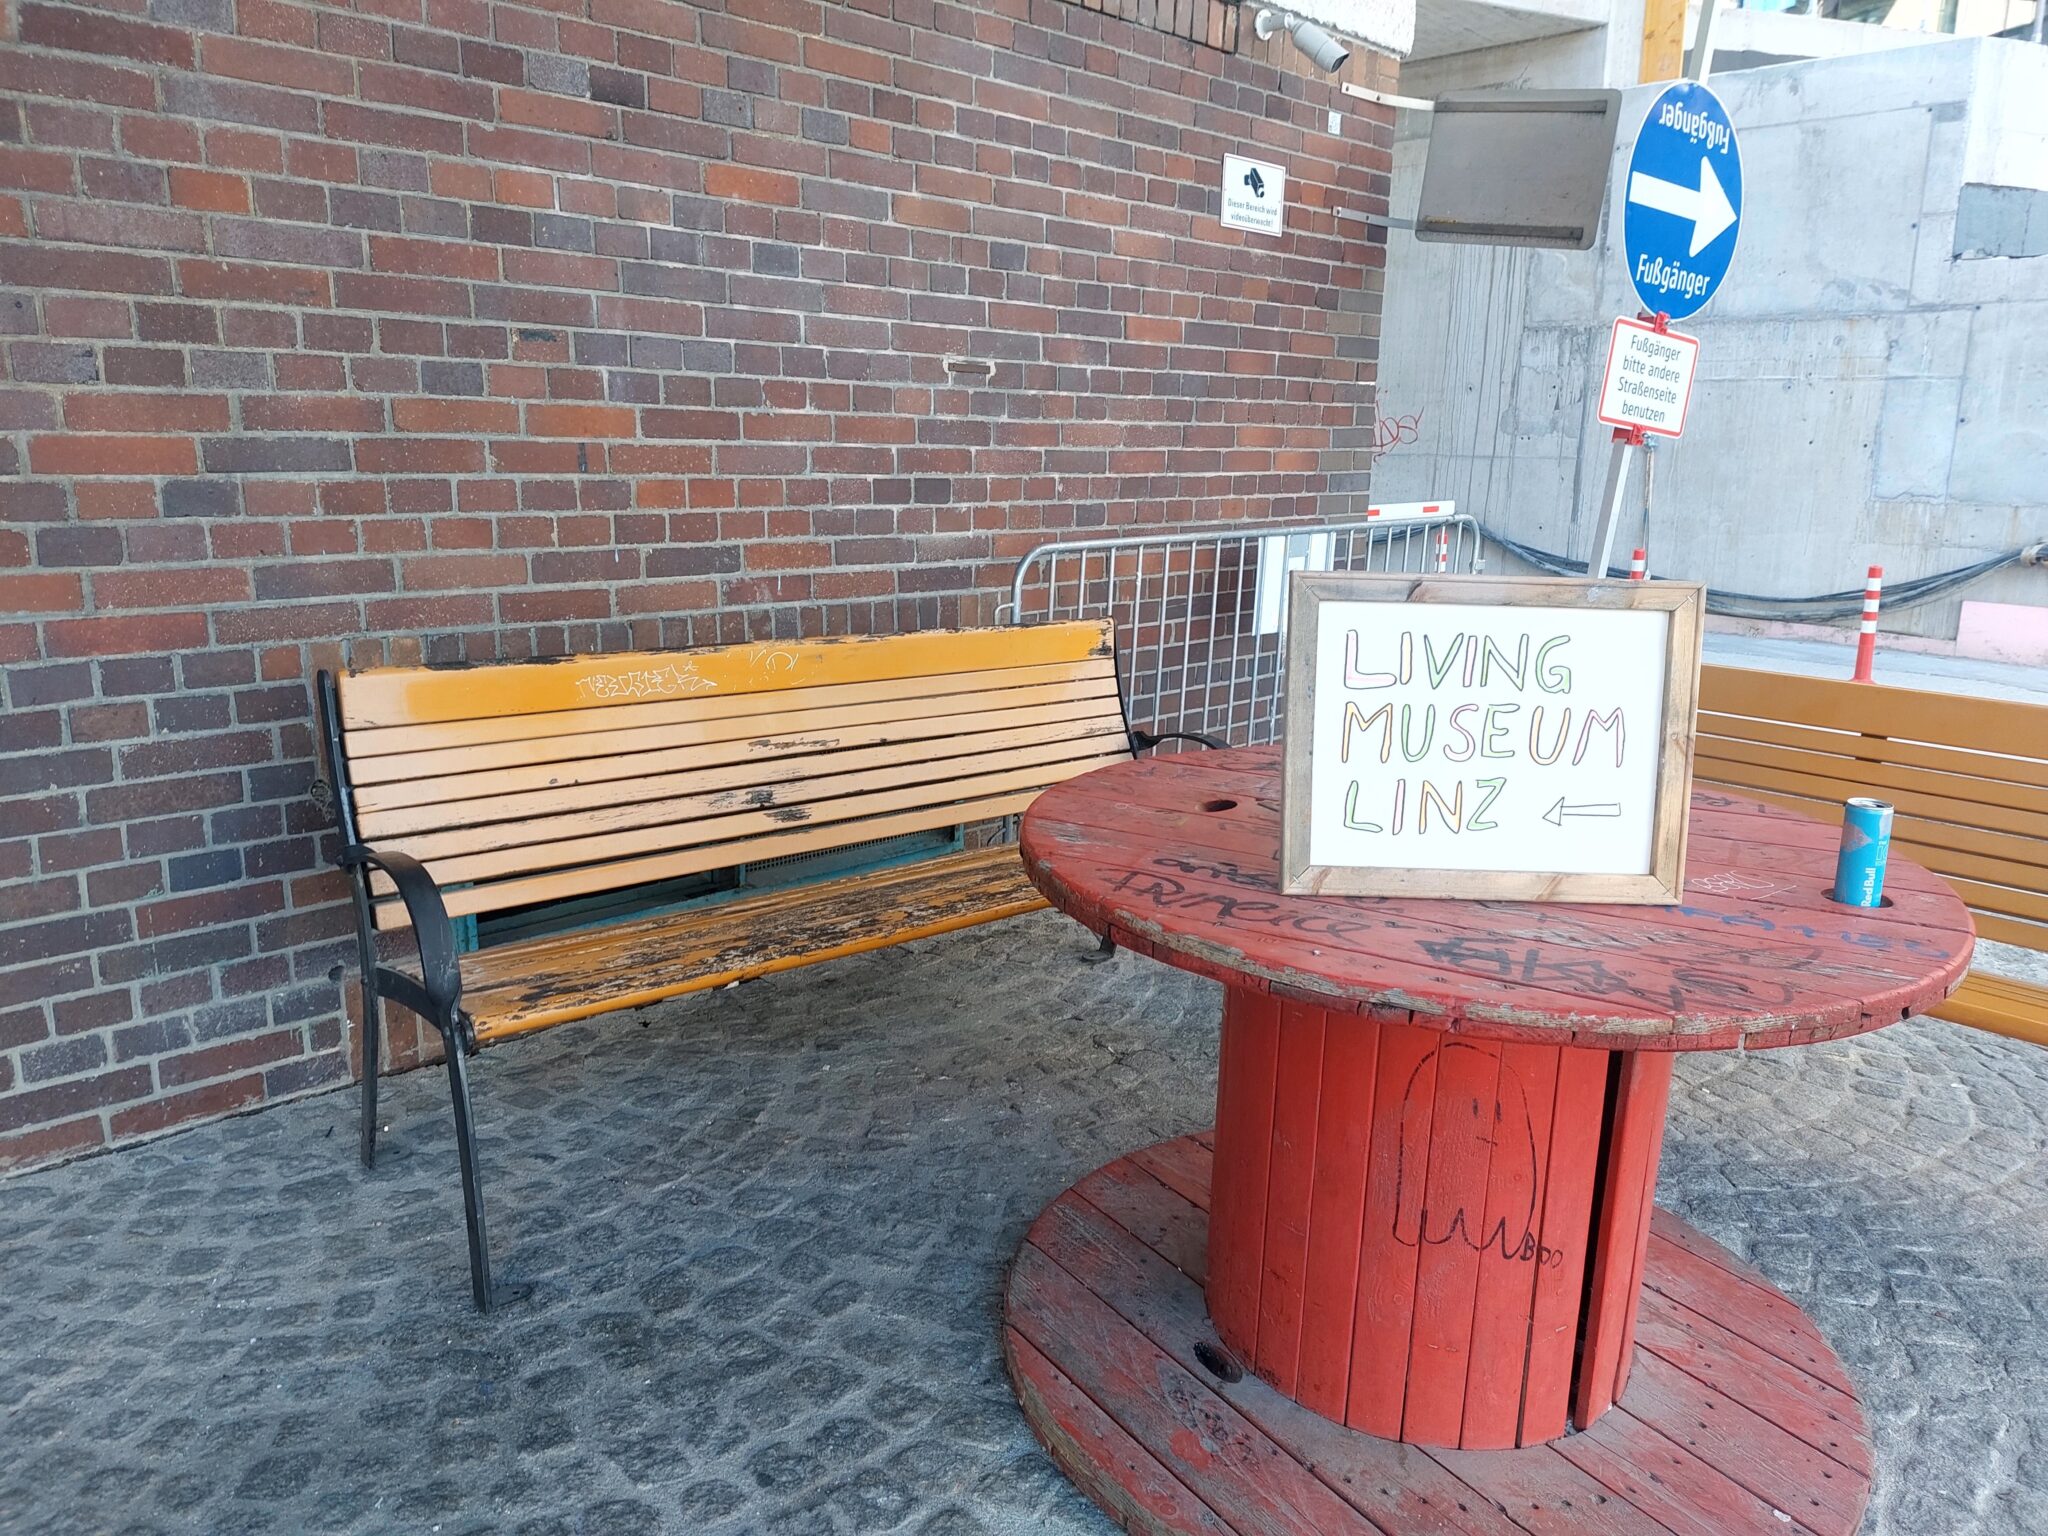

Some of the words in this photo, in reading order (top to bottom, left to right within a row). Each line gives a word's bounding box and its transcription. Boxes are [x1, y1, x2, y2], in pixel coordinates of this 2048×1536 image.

[1659, 102, 1730, 154] Fußgänger
[1228, 198, 1245, 208] Dieser
[1246, 202, 1266, 213] Bereich
[1266, 207, 1278, 216] wird
[1636, 253, 1710, 299] Fußgänger
[1630, 334, 1681, 362] Fußgänger
[1623, 355, 1646, 375] bitte
[1648, 365, 1680, 384] andere
[1617, 376, 1677, 404] Straßenseite
[1622, 400, 1665, 422] benutzen
[1344, 629, 1571, 694] LIVING
[1341, 701, 1625, 768] MUSEUM
[1344, 777, 1507, 836] LINZ
